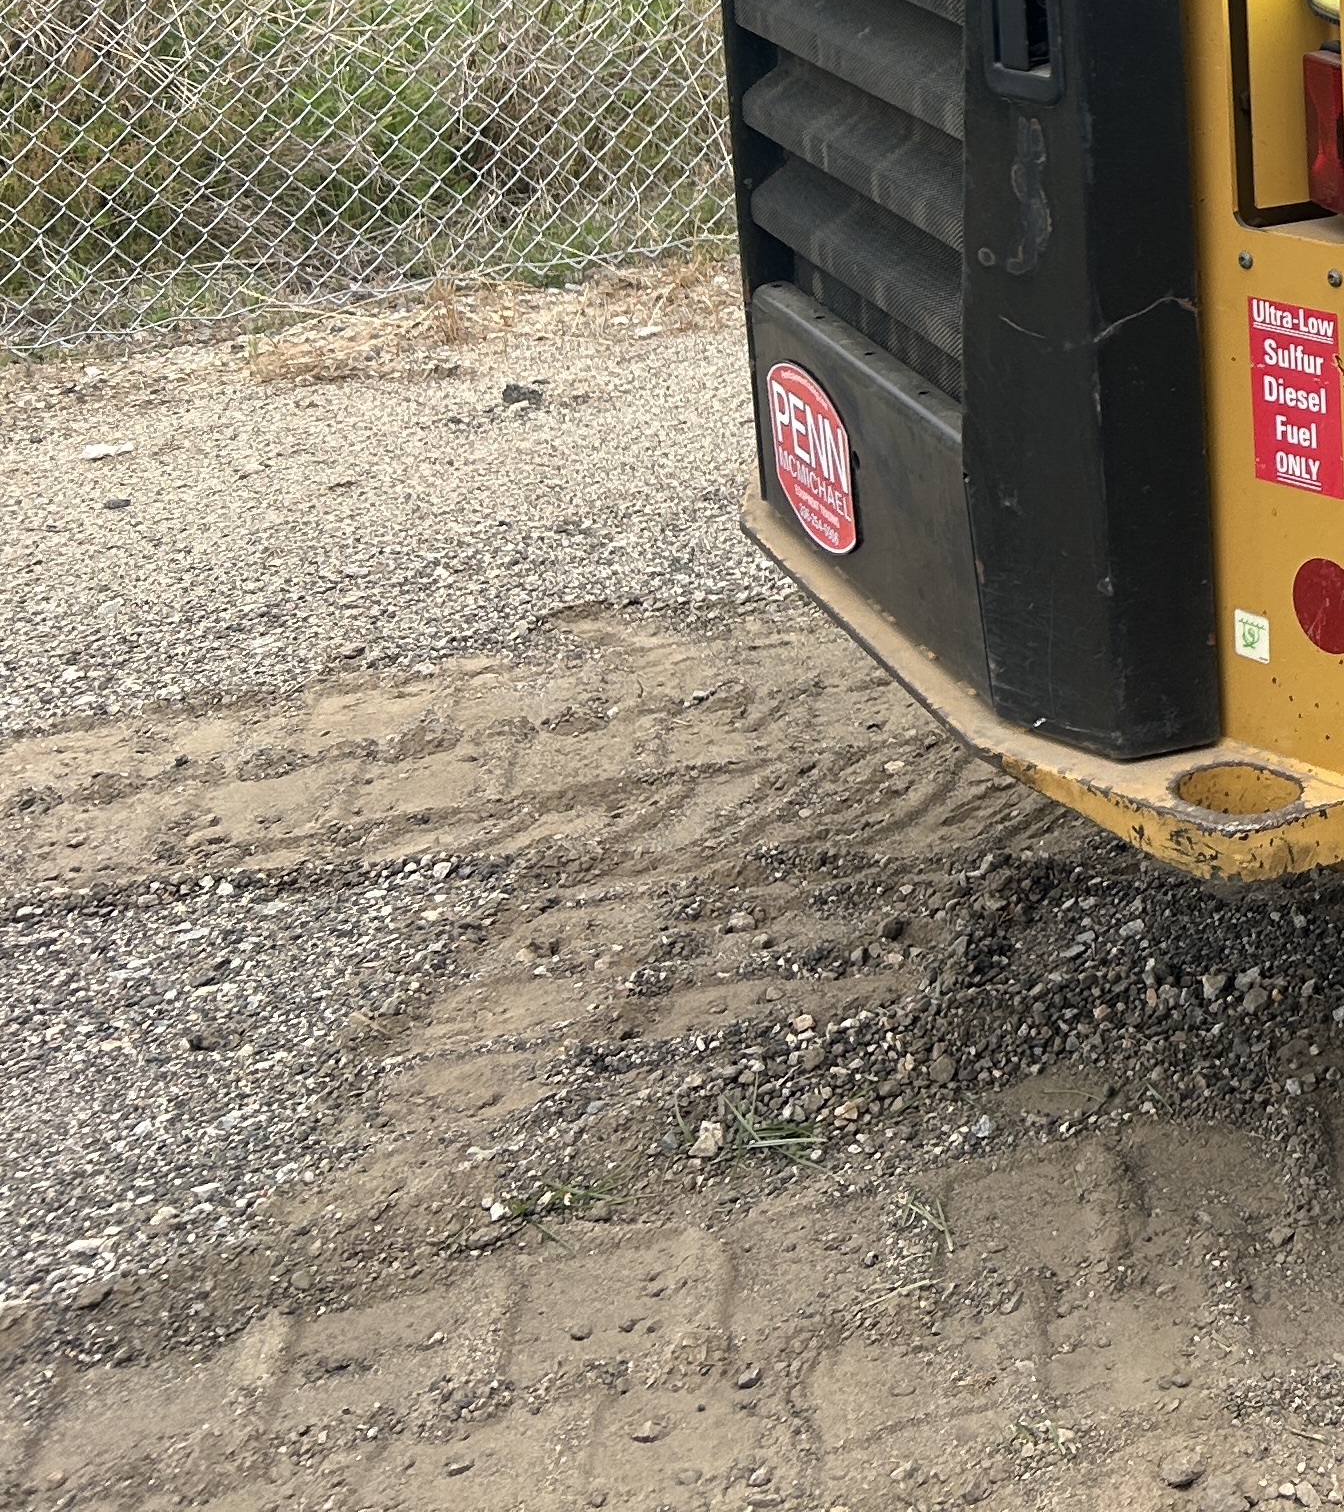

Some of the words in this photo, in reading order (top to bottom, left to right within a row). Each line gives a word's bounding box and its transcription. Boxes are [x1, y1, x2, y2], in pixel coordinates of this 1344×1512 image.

[1253, 299, 1334, 337] Ultra-Low
[1264, 339, 1324, 376] Sulfur
[1263, 375, 1326, 414] Diesel
[772, 380, 848, 494] PENN
[1275, 415, 1317, 449] Fuel
[779, 446, 851, 522] MCMICHAEL
[1276, 451, 1320, 481] ONLY
